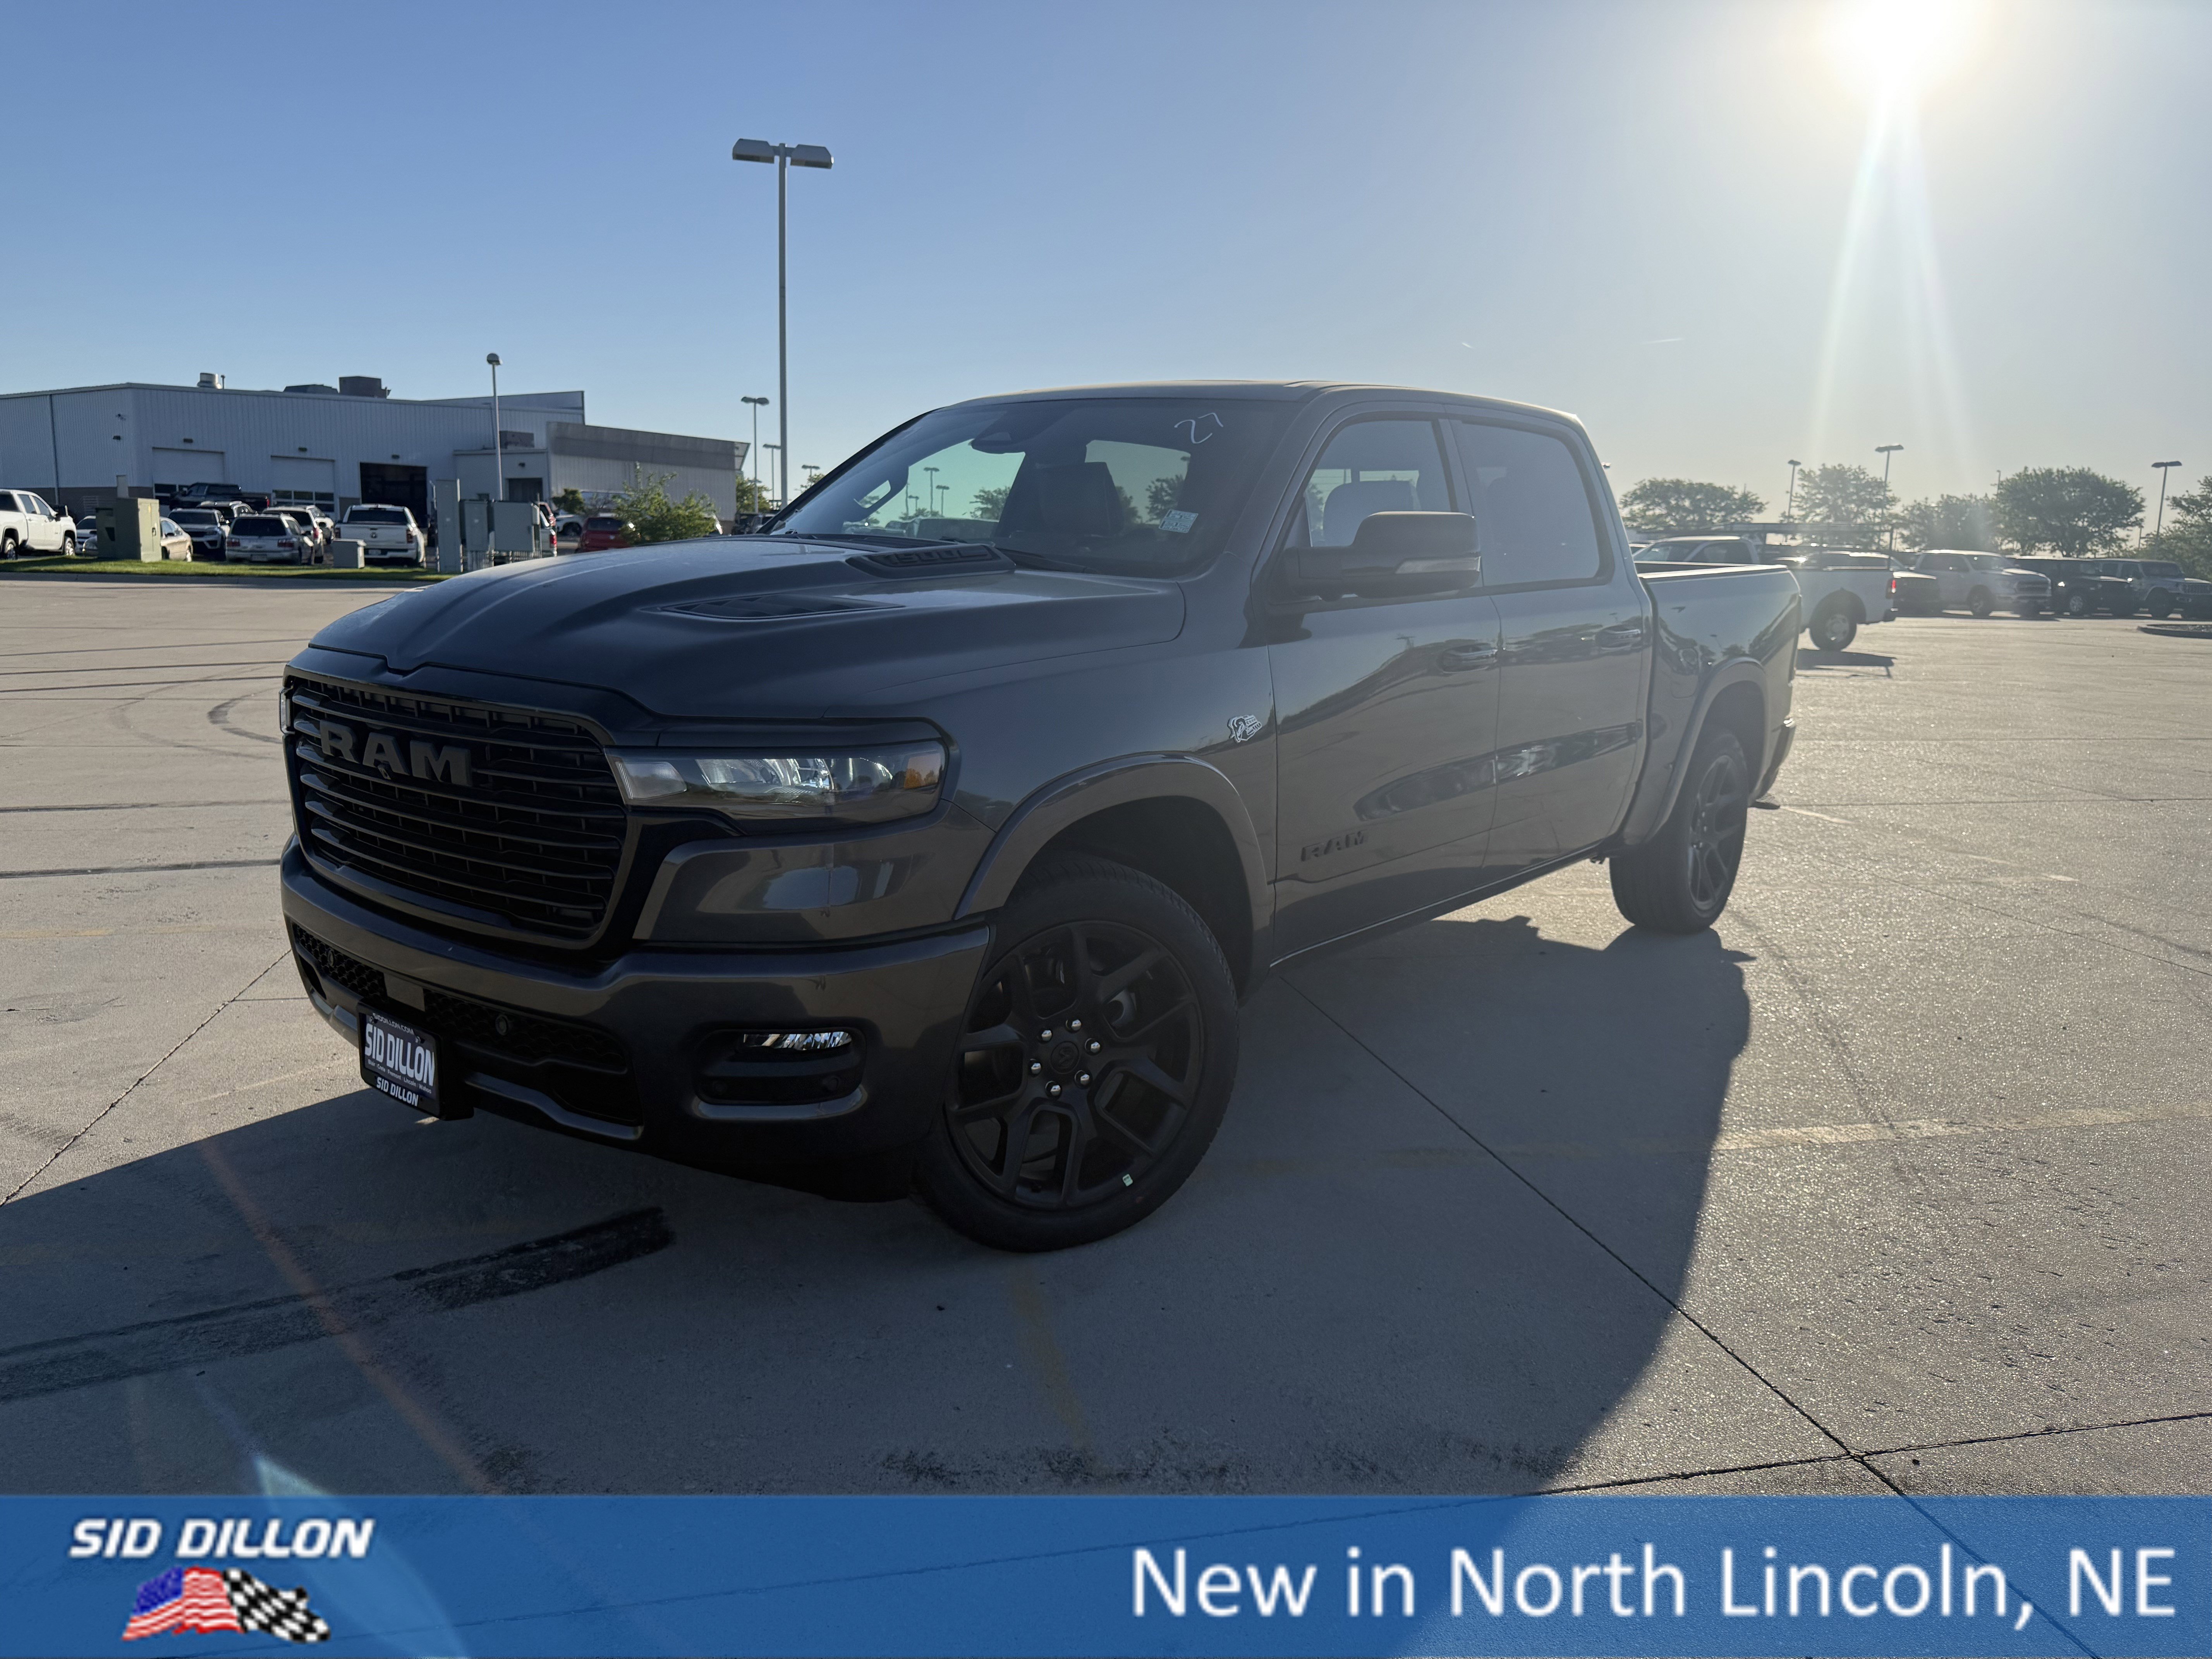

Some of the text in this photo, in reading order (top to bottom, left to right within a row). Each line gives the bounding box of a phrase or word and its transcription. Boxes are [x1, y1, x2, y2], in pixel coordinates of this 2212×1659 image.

[320, 720, 473, 787] RAM
[1300, 830, 1369, 862] RAM
[365, 1023, 435, 1086] SID DILLON
[376, 1077, 419, 1107] SID DILLON
